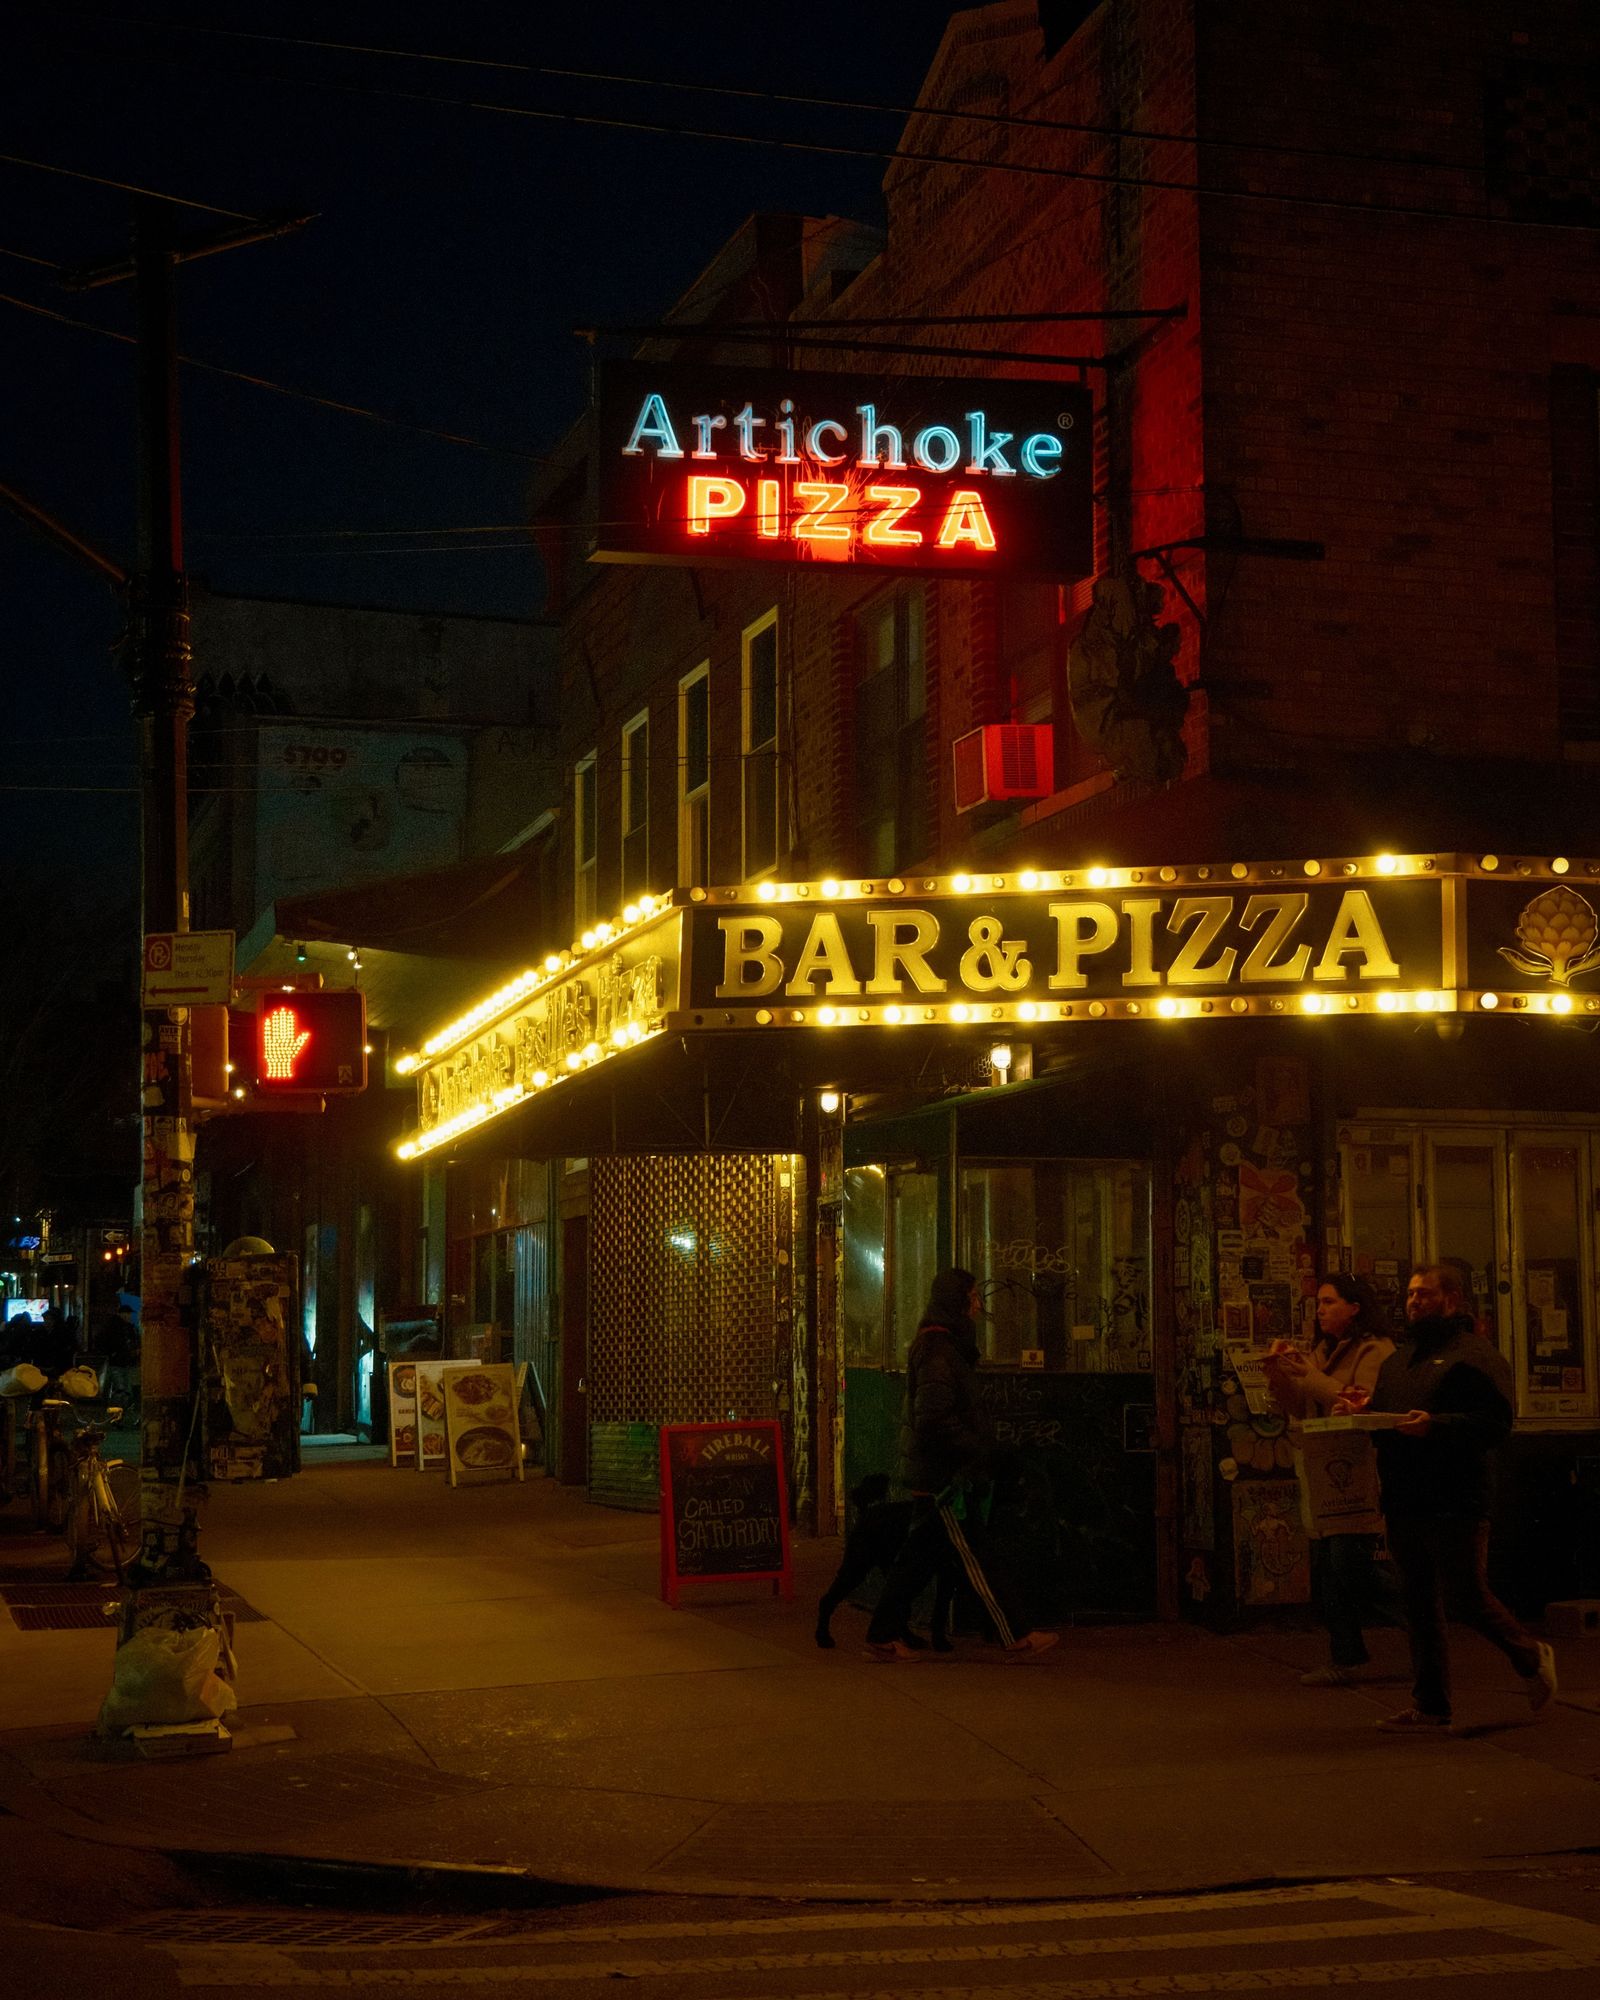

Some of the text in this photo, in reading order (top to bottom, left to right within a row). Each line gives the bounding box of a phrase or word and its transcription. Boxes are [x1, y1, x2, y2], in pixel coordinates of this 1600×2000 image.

[622, 393, 1063, 478] Artichoke
[686, 475, 997, 552] PIZZA
[716, 890, 1400, 998] BAR & PIZZA
[701, 1433, 771, 1461] FIREBALL
[677, 1517, 781, 1551] SATURDAY
[684, 1497, 745, 1519] CALLED
